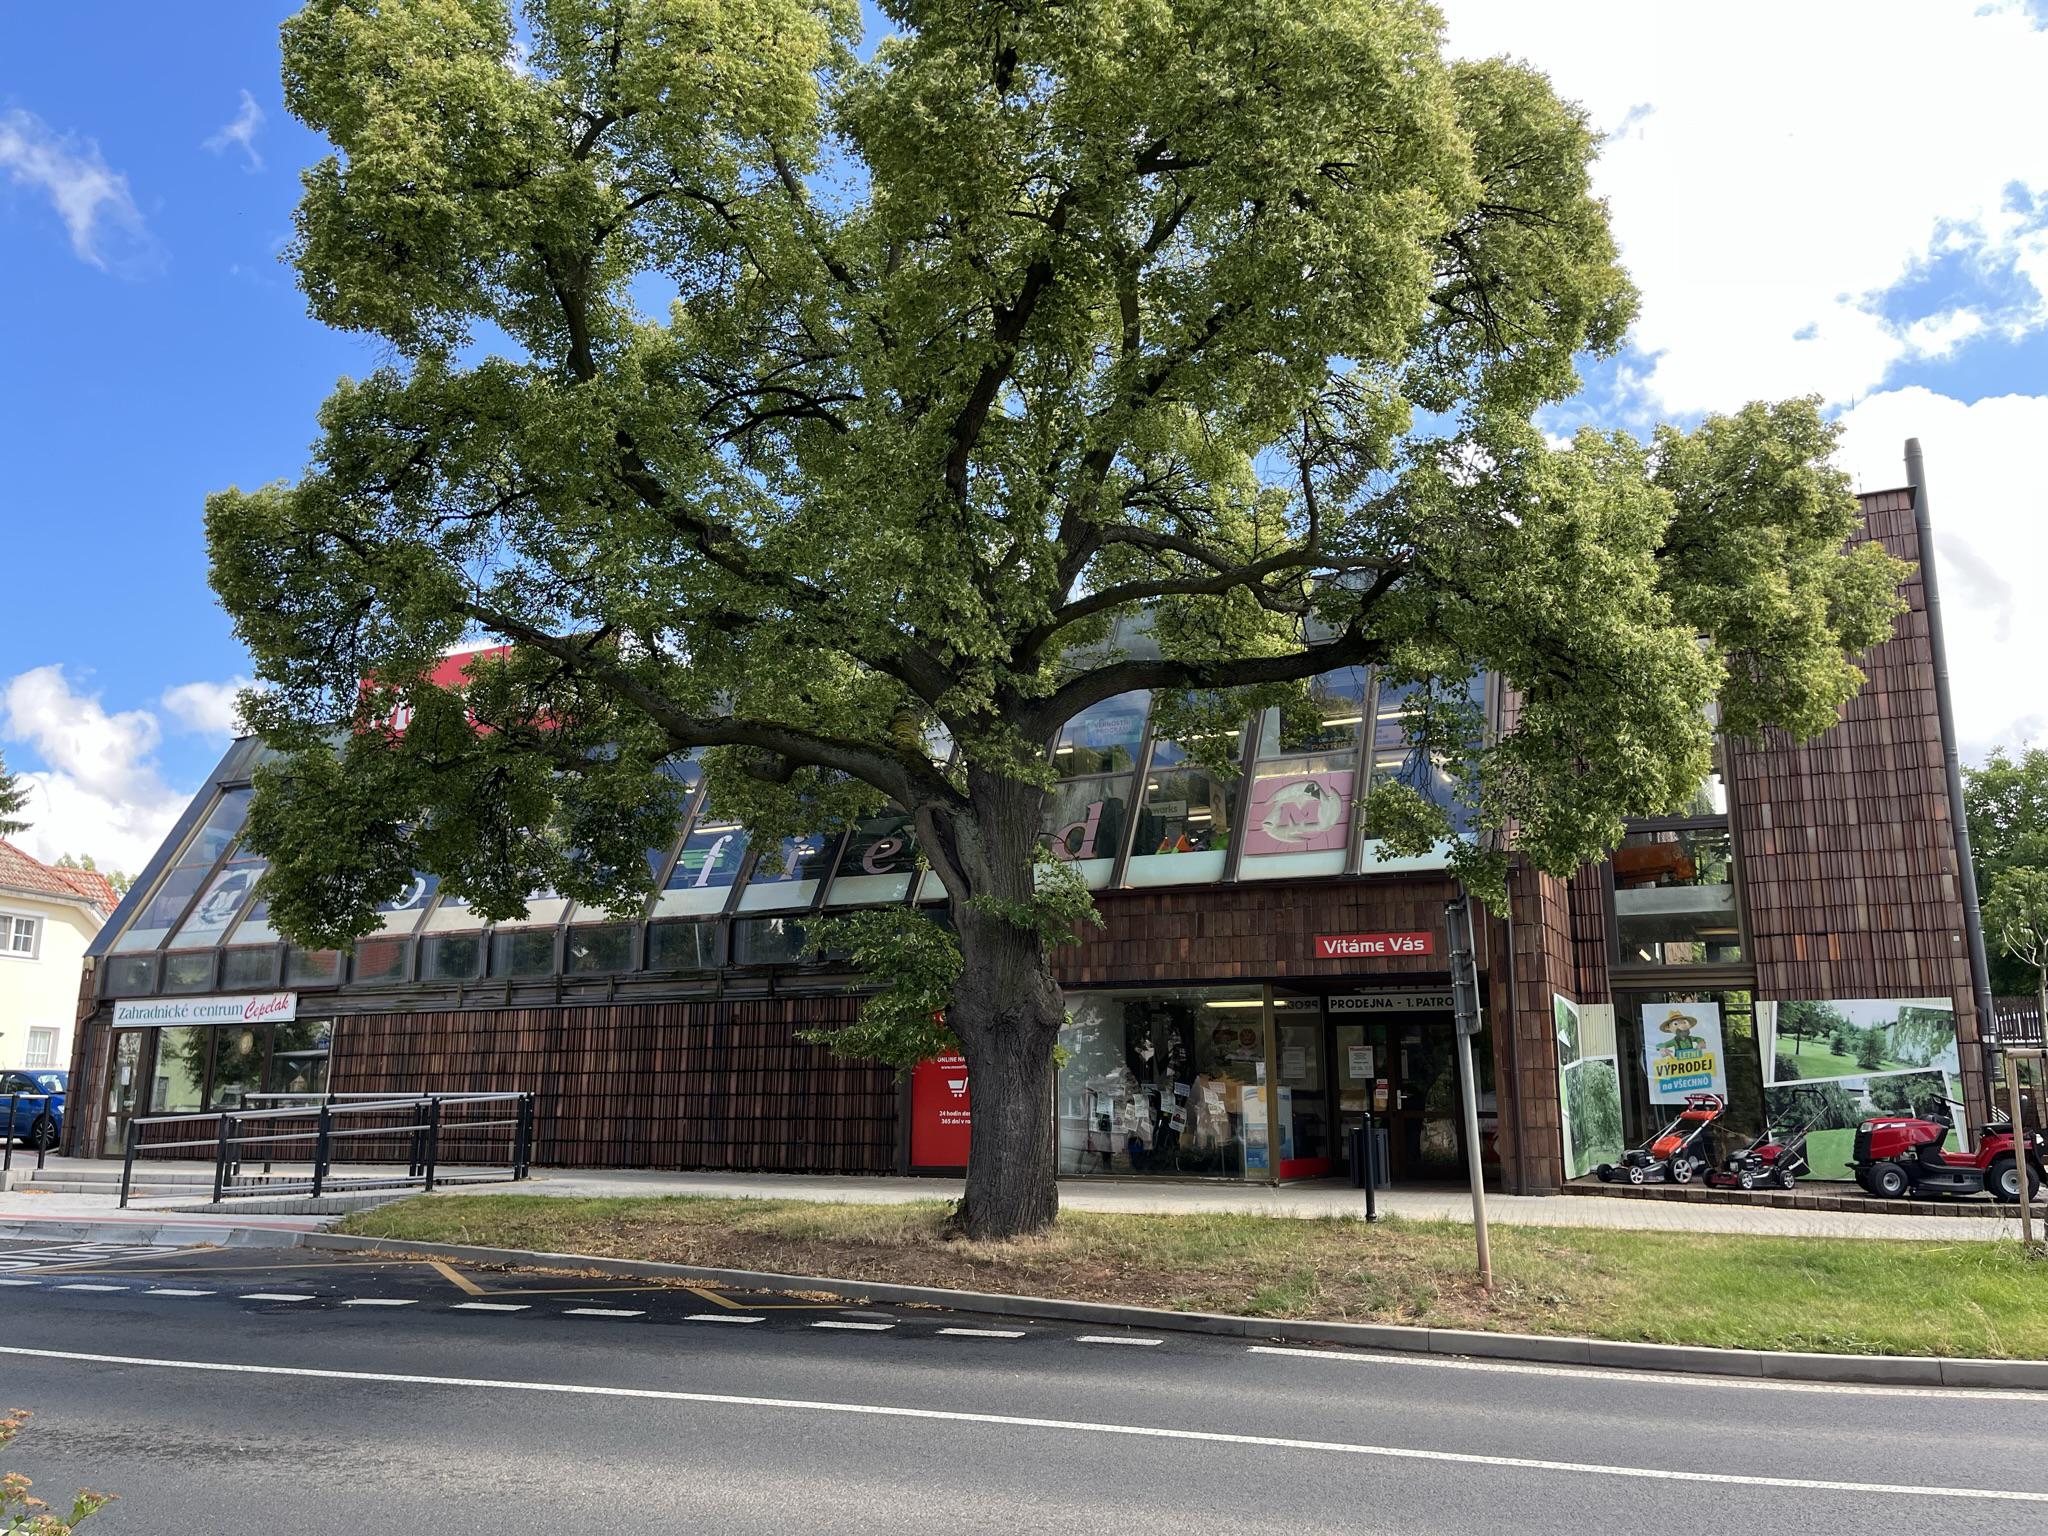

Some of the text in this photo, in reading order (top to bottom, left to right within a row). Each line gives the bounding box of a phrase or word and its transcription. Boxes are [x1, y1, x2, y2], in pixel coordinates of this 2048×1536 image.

[1324, 937, 1425, 954] Vítáme Vás
[117, 992, 289, 1021] Zahradnické centrum Čepelák
[1330, 998, 1394, 1010] PRODEJNA
[1656, 1059, 1712, 1077] VÝPRODEJ
